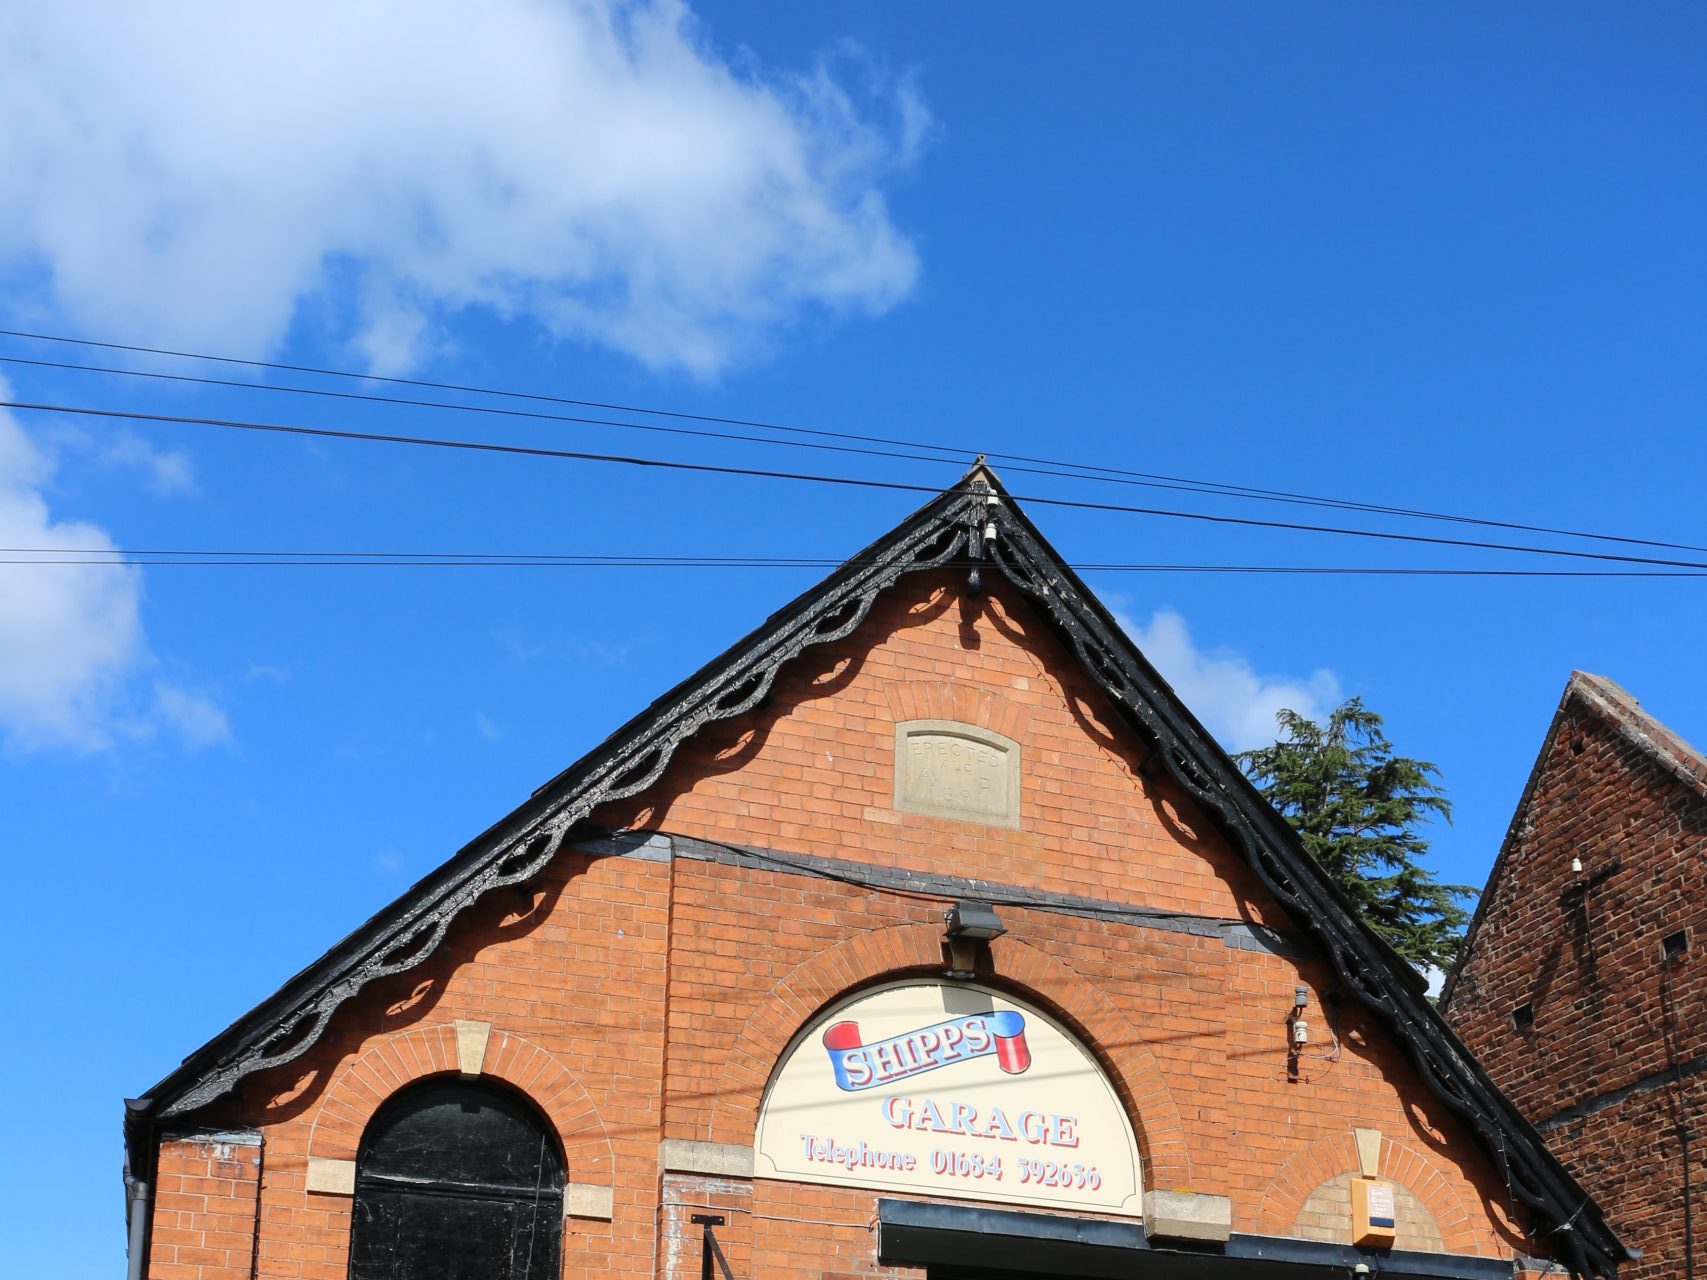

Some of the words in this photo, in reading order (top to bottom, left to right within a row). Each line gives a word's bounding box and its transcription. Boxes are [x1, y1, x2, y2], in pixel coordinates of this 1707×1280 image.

[910, 741, 999, 768] ERECTED
[842, 1015, 992, 1087] SHIPPS
[881, 1095, 1080, 1148] GARAGE
[800, 1134, 917, 1171] Telephone
[930, 1149, 1003, 1181] 01684
[1017, 1156, 1102, 1190] 592656
